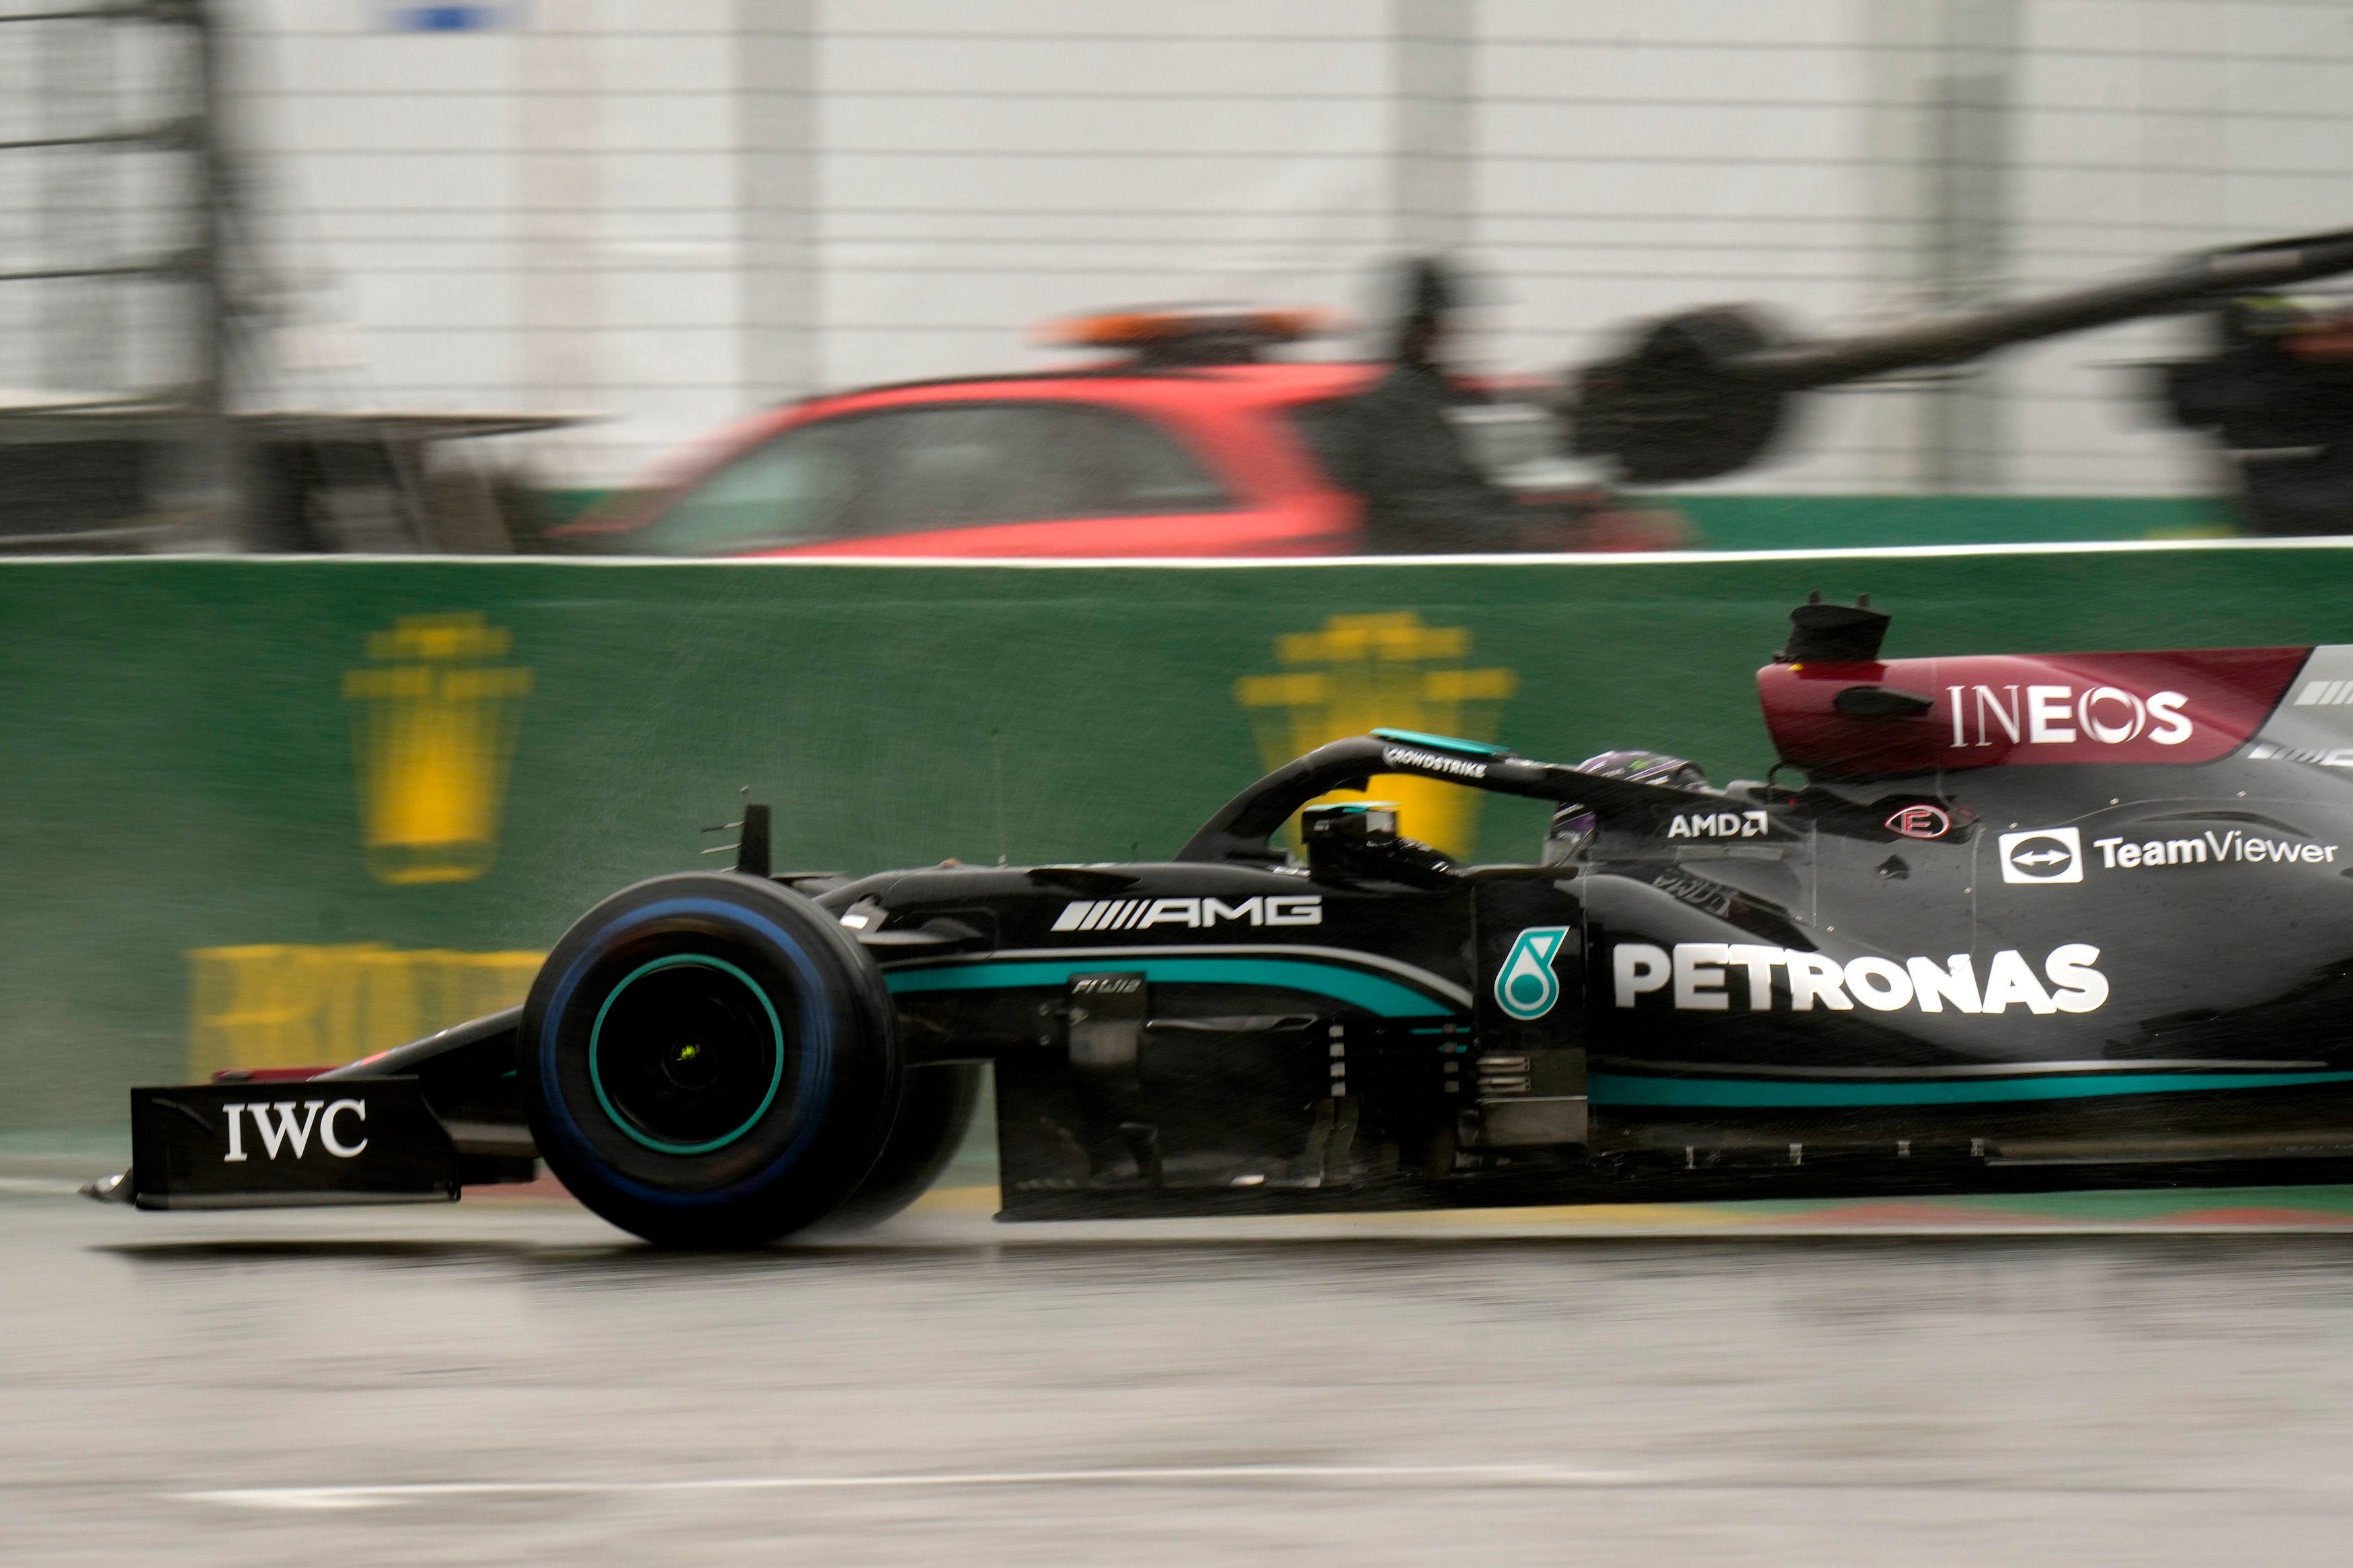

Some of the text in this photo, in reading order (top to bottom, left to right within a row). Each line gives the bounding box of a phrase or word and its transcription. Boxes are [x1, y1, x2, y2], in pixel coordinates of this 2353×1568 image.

[1946, 684, 2194, 747] INEOS
[1388, 747, 1488, 779] CROWDSTRIKE
[1667, 813, 1741, 838] AMD
[1901, 810, 1933, 836] E
[2093, 830, 2340, 869] TeamViewer
[1136, 895, 1322, 929] AMG
[1614, 943, 2110, 1015] PETRONAS
[223, 1100, 368, 1162] IWC
